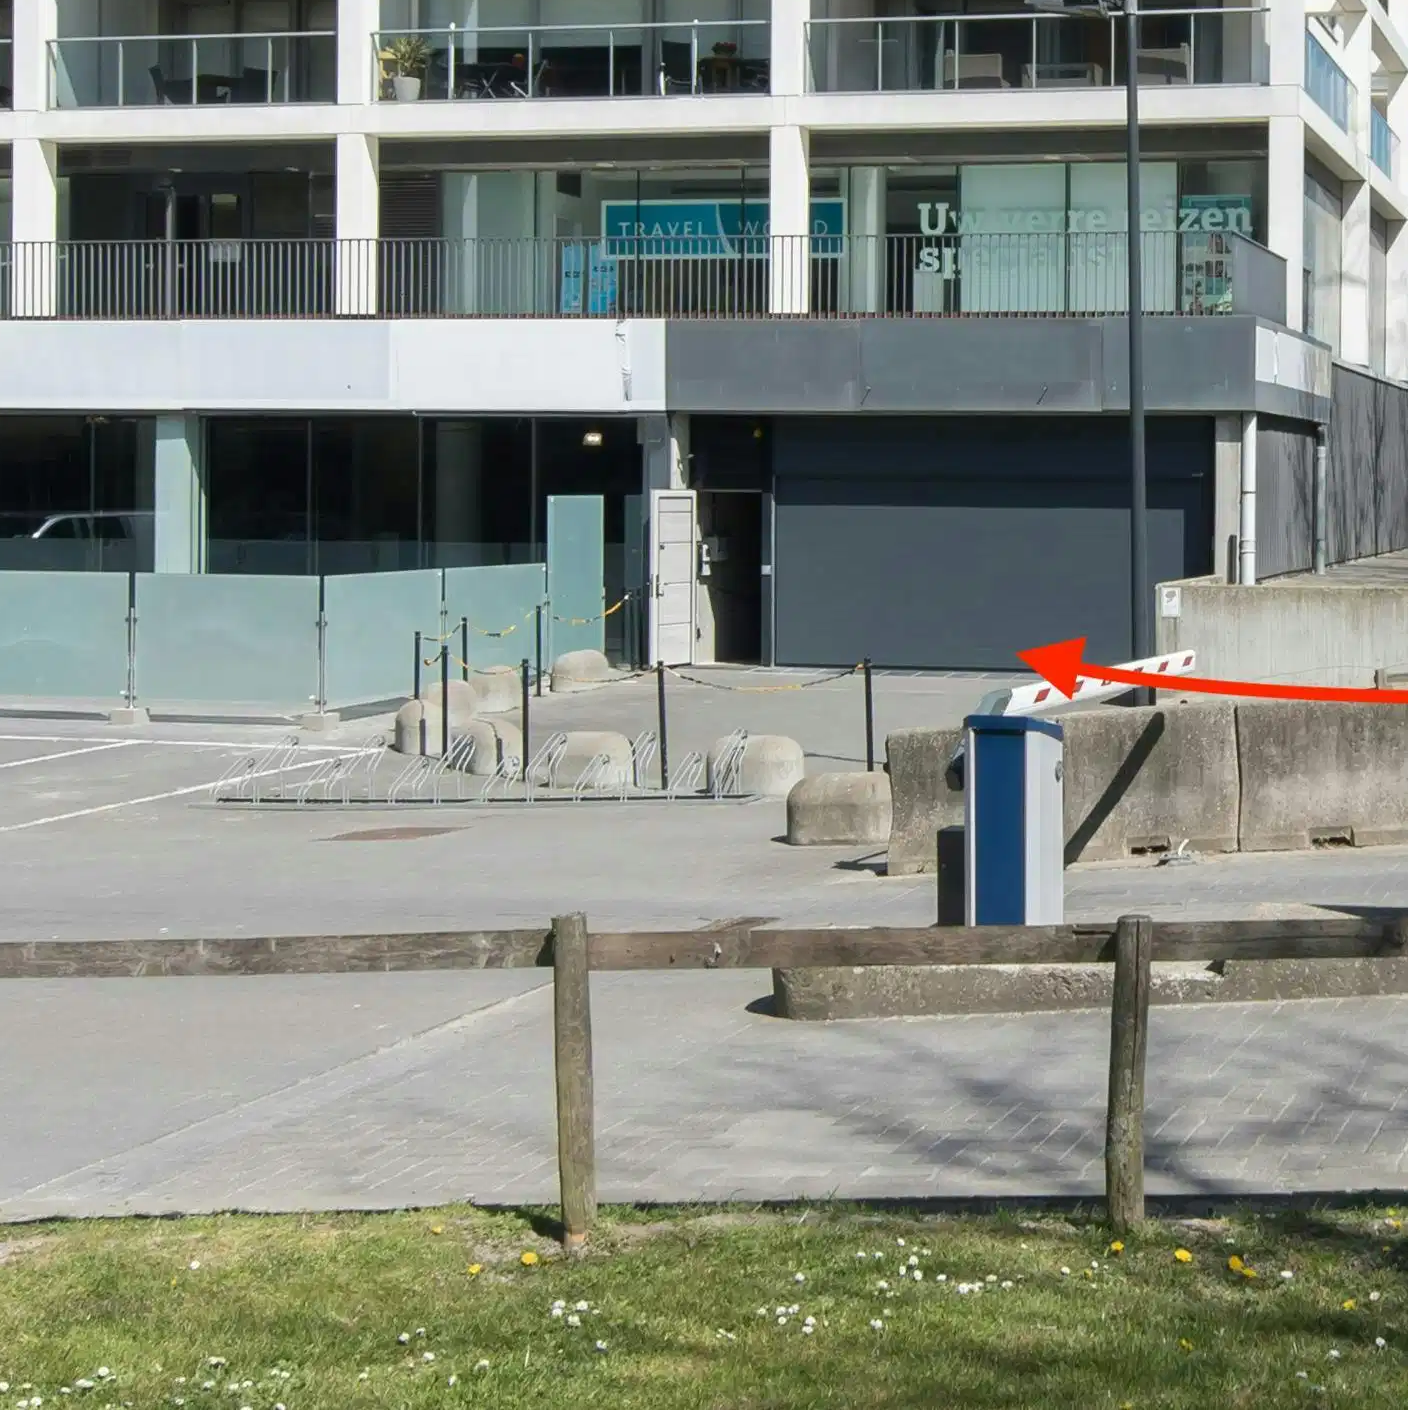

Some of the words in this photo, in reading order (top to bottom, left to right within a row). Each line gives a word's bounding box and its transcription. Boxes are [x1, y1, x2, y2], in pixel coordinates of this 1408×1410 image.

[617, 220, 706, 238] TRAVEL
[738, 219, 828, 238] WOD
[1122, 199, 1253, 233] eizen
